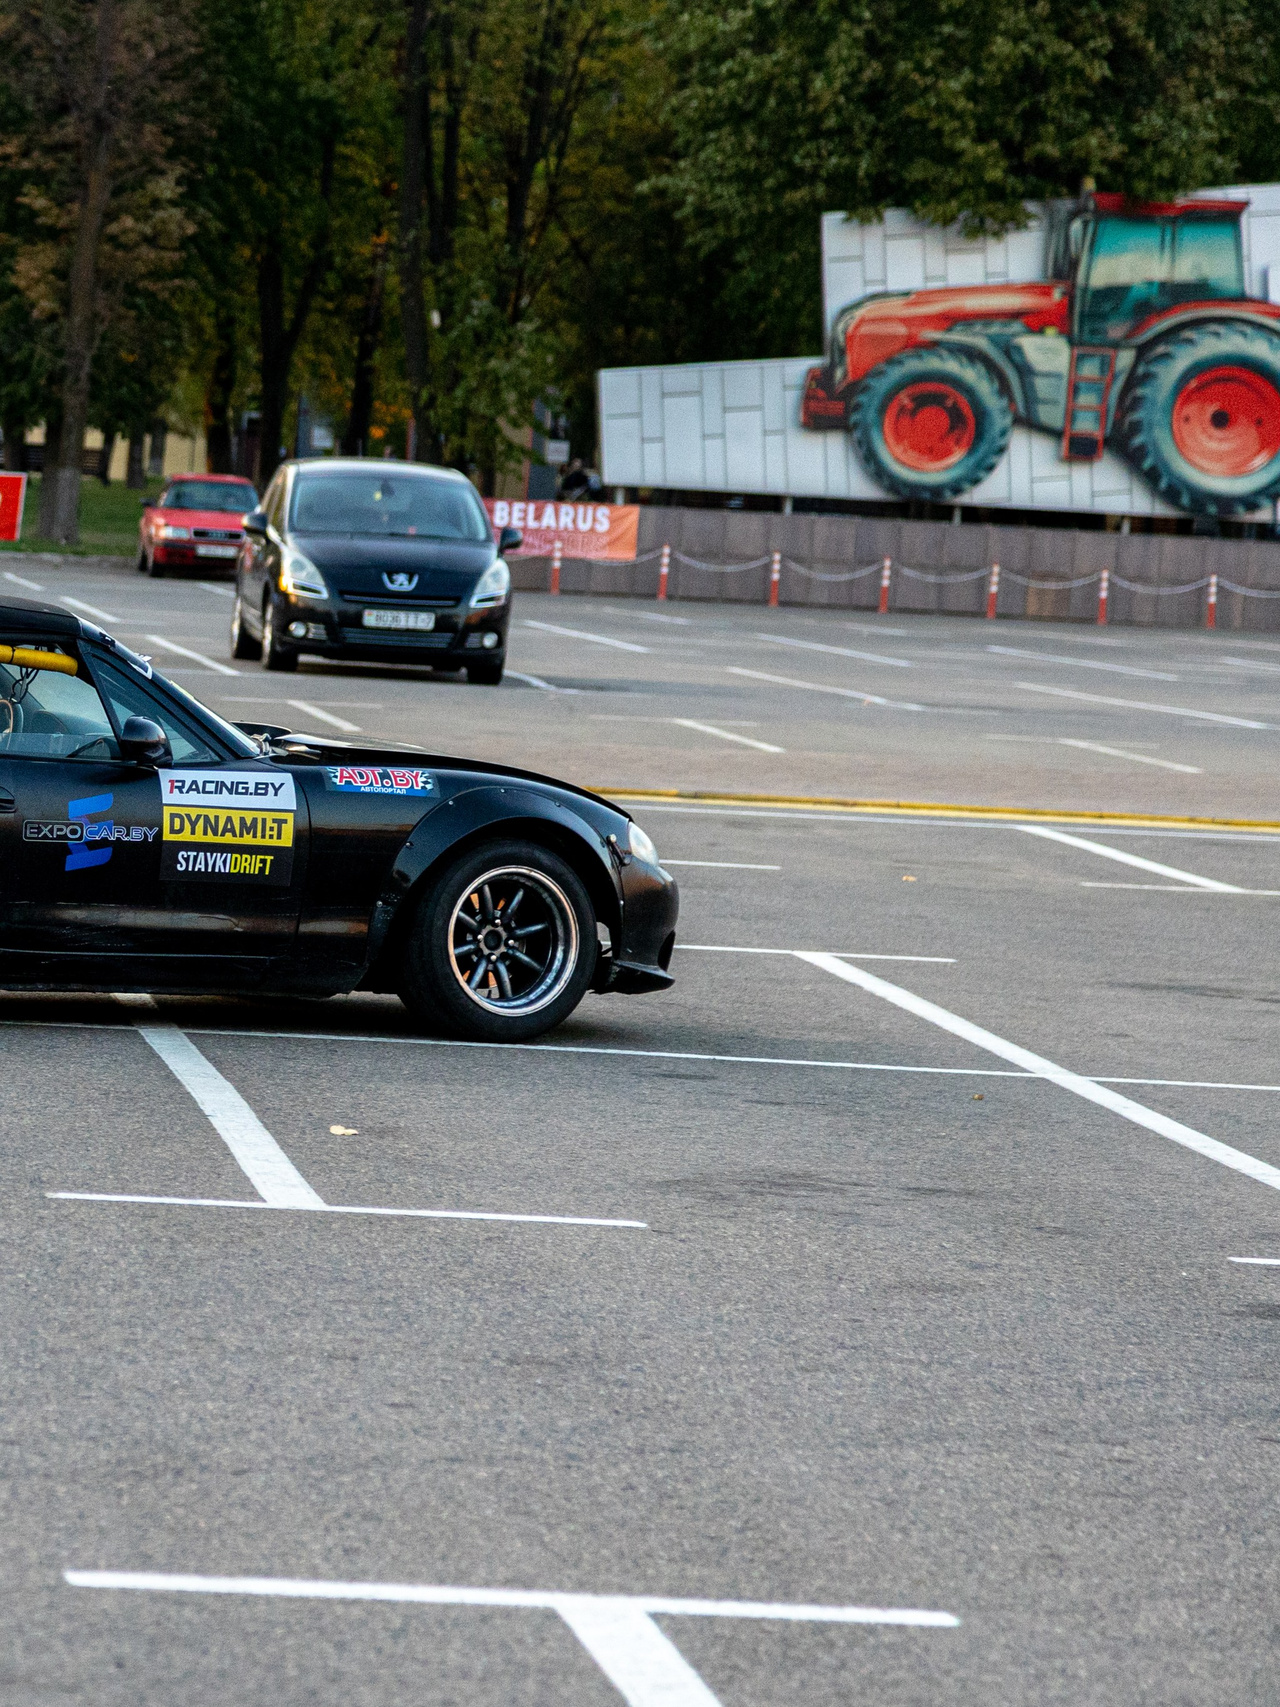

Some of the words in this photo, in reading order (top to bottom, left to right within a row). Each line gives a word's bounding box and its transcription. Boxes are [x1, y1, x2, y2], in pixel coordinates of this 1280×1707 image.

[493, 500, 611, 533] BELARUS
[168, 779, 286, 797] 1RACING.BY
[336, 767, 422, 790] ADT.BY
[360, 785, 407, 795] АВТОПОРТАЛ
[176, 851, 274, 875] STAYKIDRIFT
